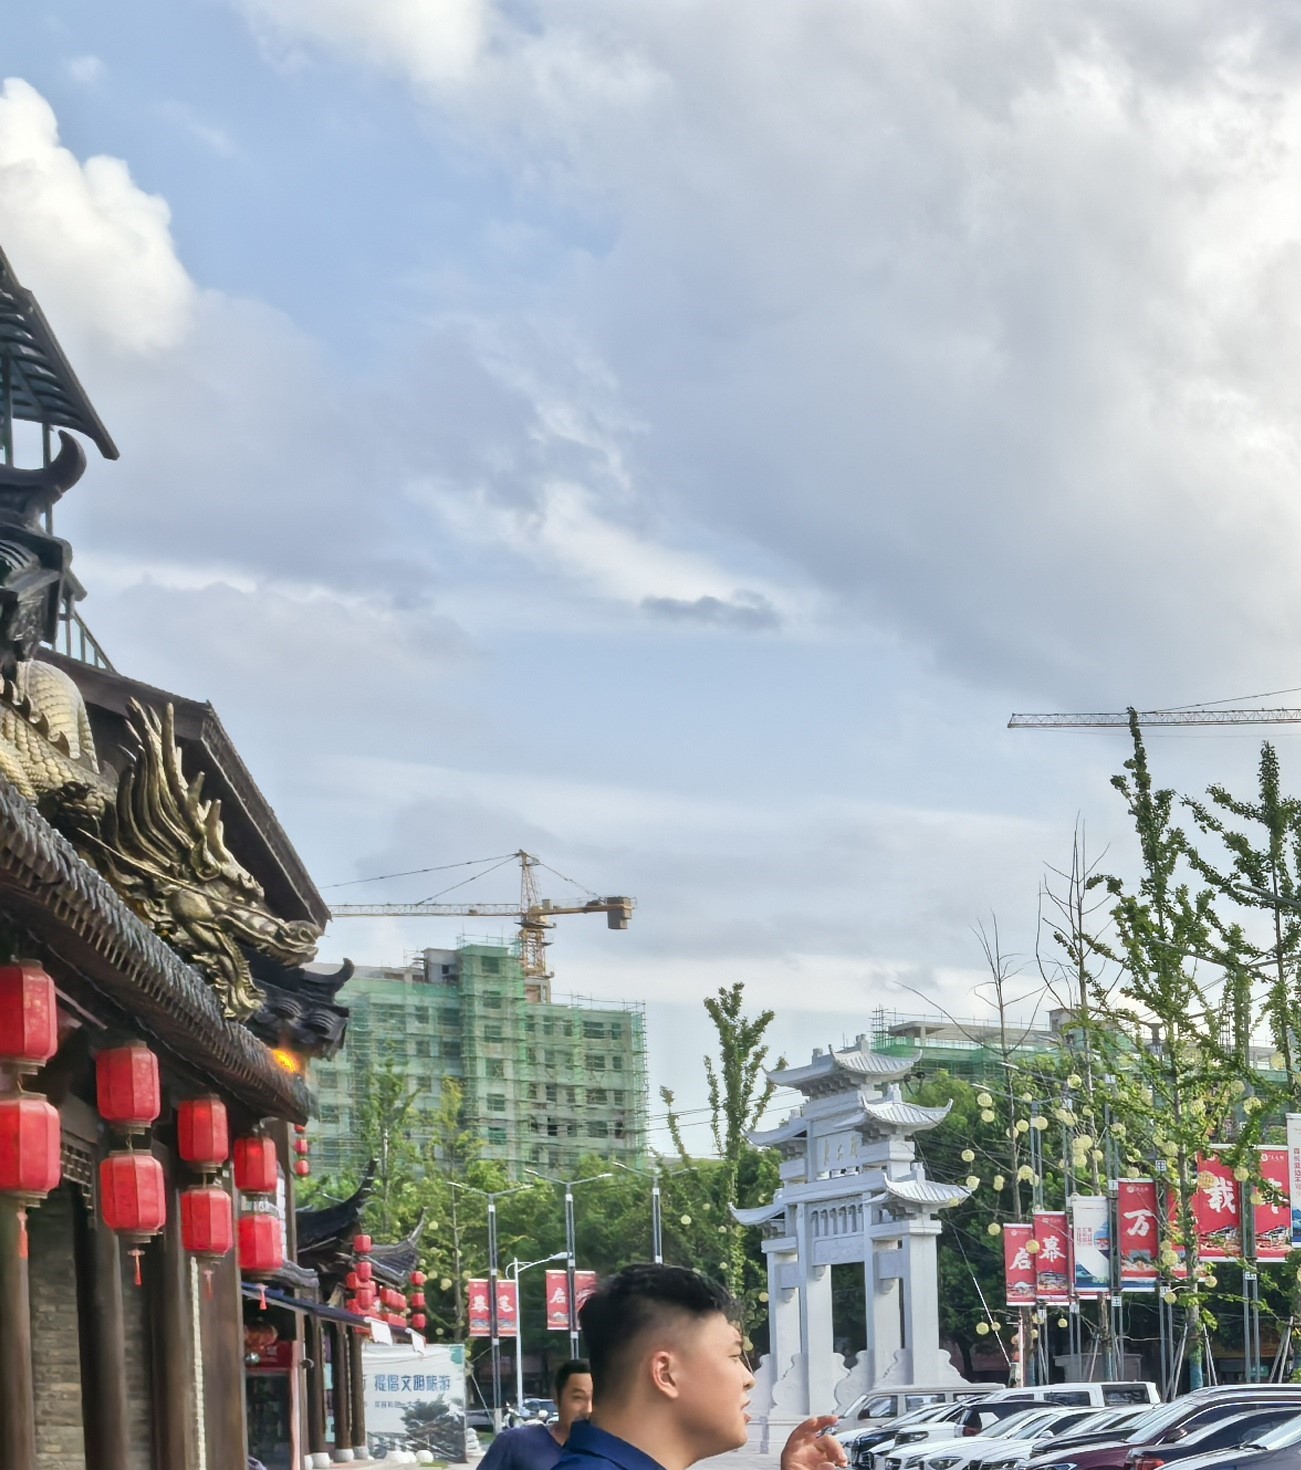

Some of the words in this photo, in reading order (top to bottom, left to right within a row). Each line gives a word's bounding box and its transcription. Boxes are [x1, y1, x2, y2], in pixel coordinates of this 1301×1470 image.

[1123, 1208, 1154, 1237] 万
[1039, 1234, 1067, 1263] 幕
[374, 1374, 451, 1392] 提倡文明旅游
